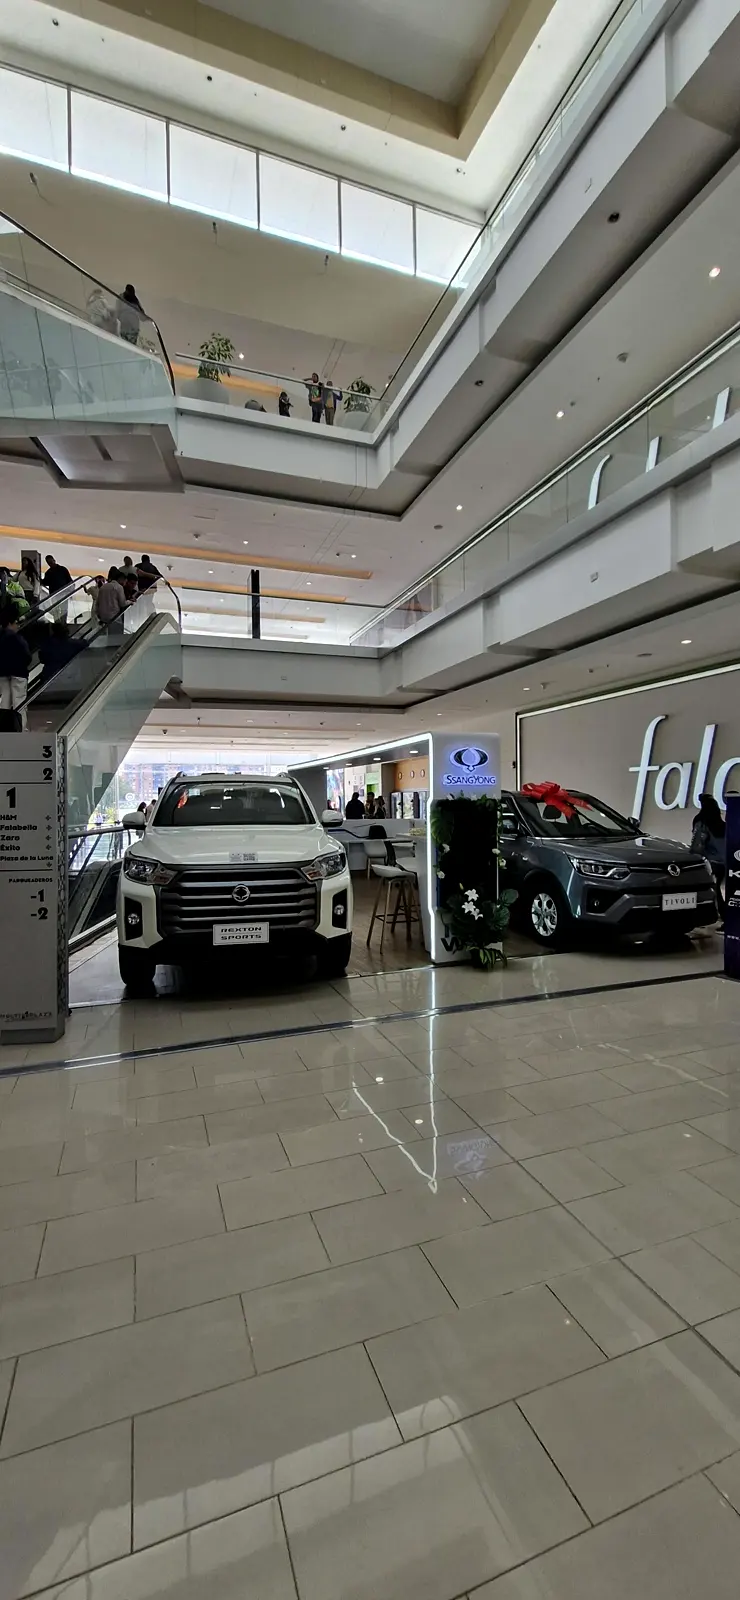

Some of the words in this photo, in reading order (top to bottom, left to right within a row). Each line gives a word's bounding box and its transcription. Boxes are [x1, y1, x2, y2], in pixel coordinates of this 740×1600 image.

[42, 746, 52, 758] 3
[43, 768, 53, 780] 2
[6, 787, 16, 808] 1
[31, 888, 45, 902] -1
[664, 897, 695, 906] TIVOLI
[31, 907, 48, 920] -2
